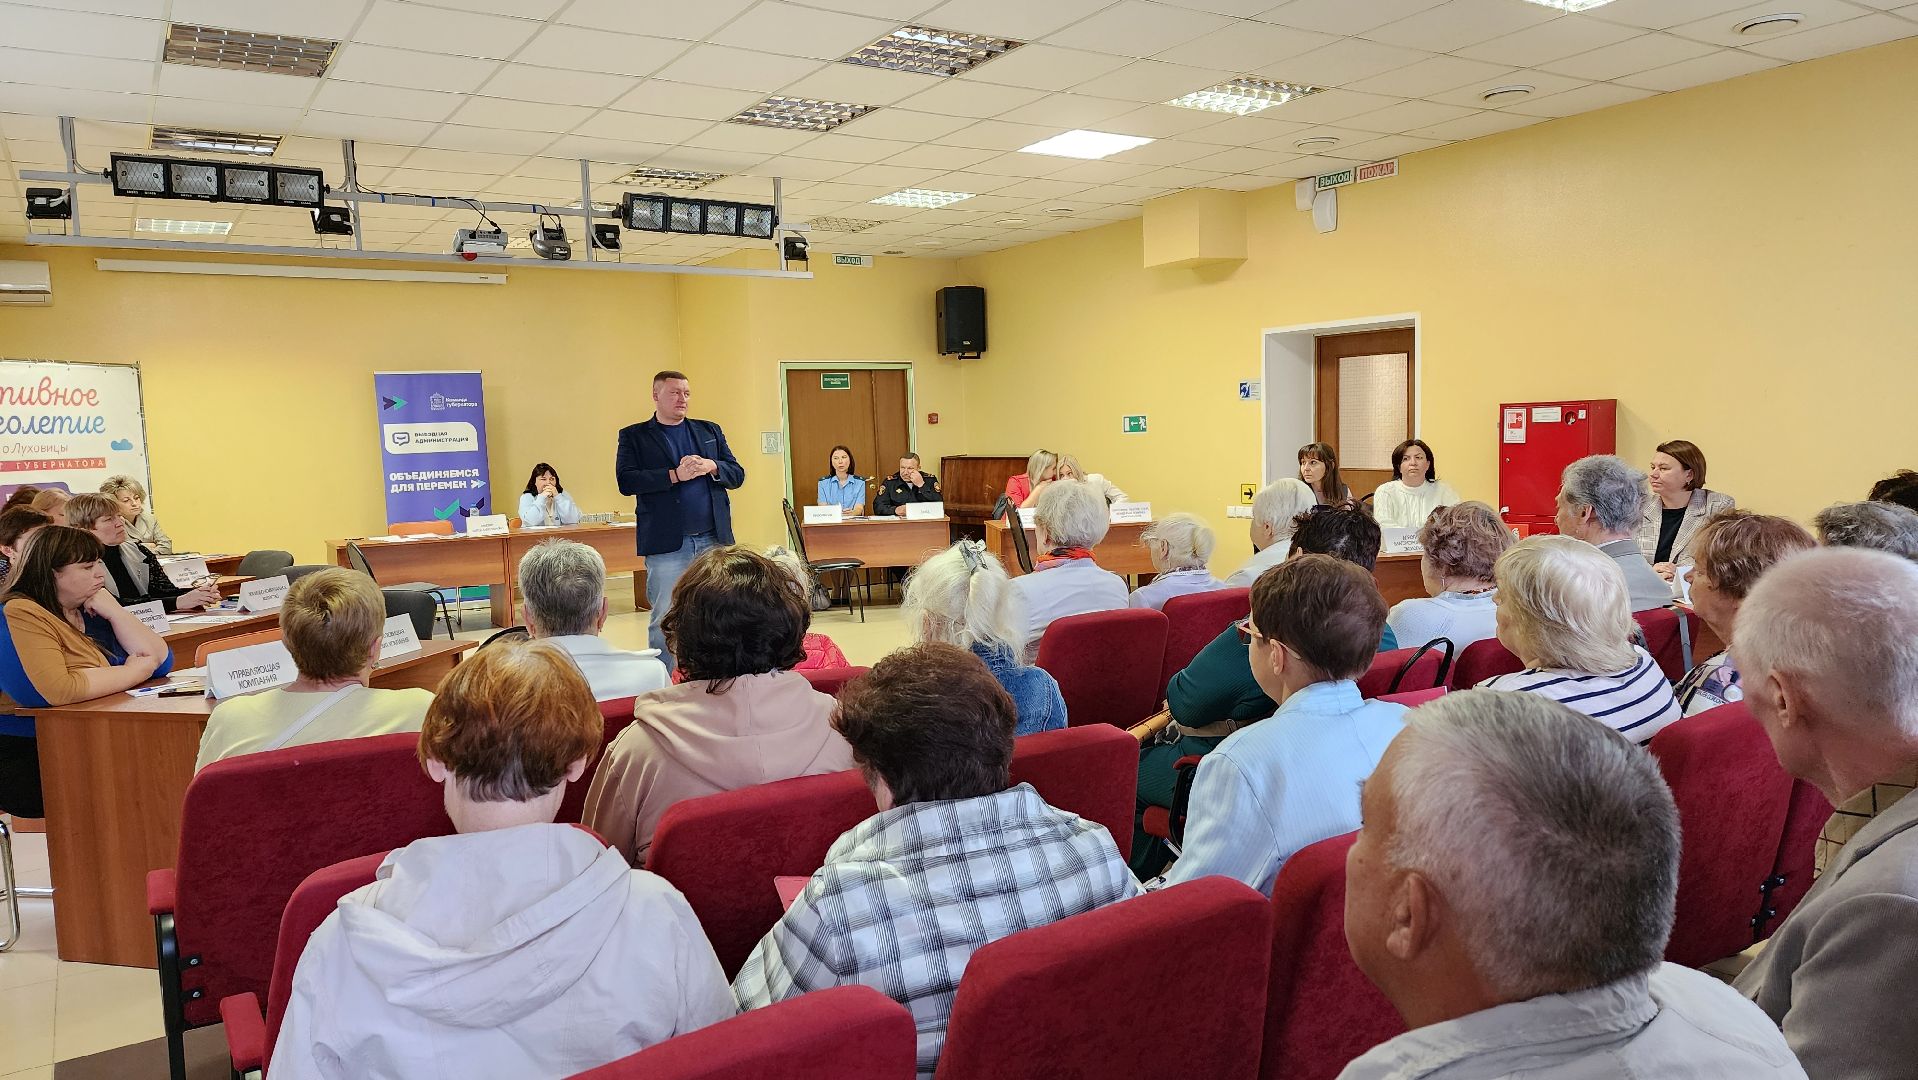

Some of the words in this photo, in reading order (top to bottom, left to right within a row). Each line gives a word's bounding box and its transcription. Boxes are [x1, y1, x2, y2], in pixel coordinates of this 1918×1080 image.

[1361, 163, 1394, 180] ПОЖАР
[1320, 171, 1351, 187] ВЫХОД
[837, 256, 861, 265] ВЫХОД
[12, 443, 69, 456] Луховицы
[16, 460, 104, 469] ГУБЕРНАТОРА
[389, 468, 480, 482] ОБЪЕДИНЯЕМСЯ
[390, 483, 415, 494] ДЛЯ
[416, 480, 467, 491] ПЕРЕМЕН
[228, 662, 281, 680] УПРАВЛЯЮЩАЯ
[238, 673, 277, 690] КОМПАНИЯ
